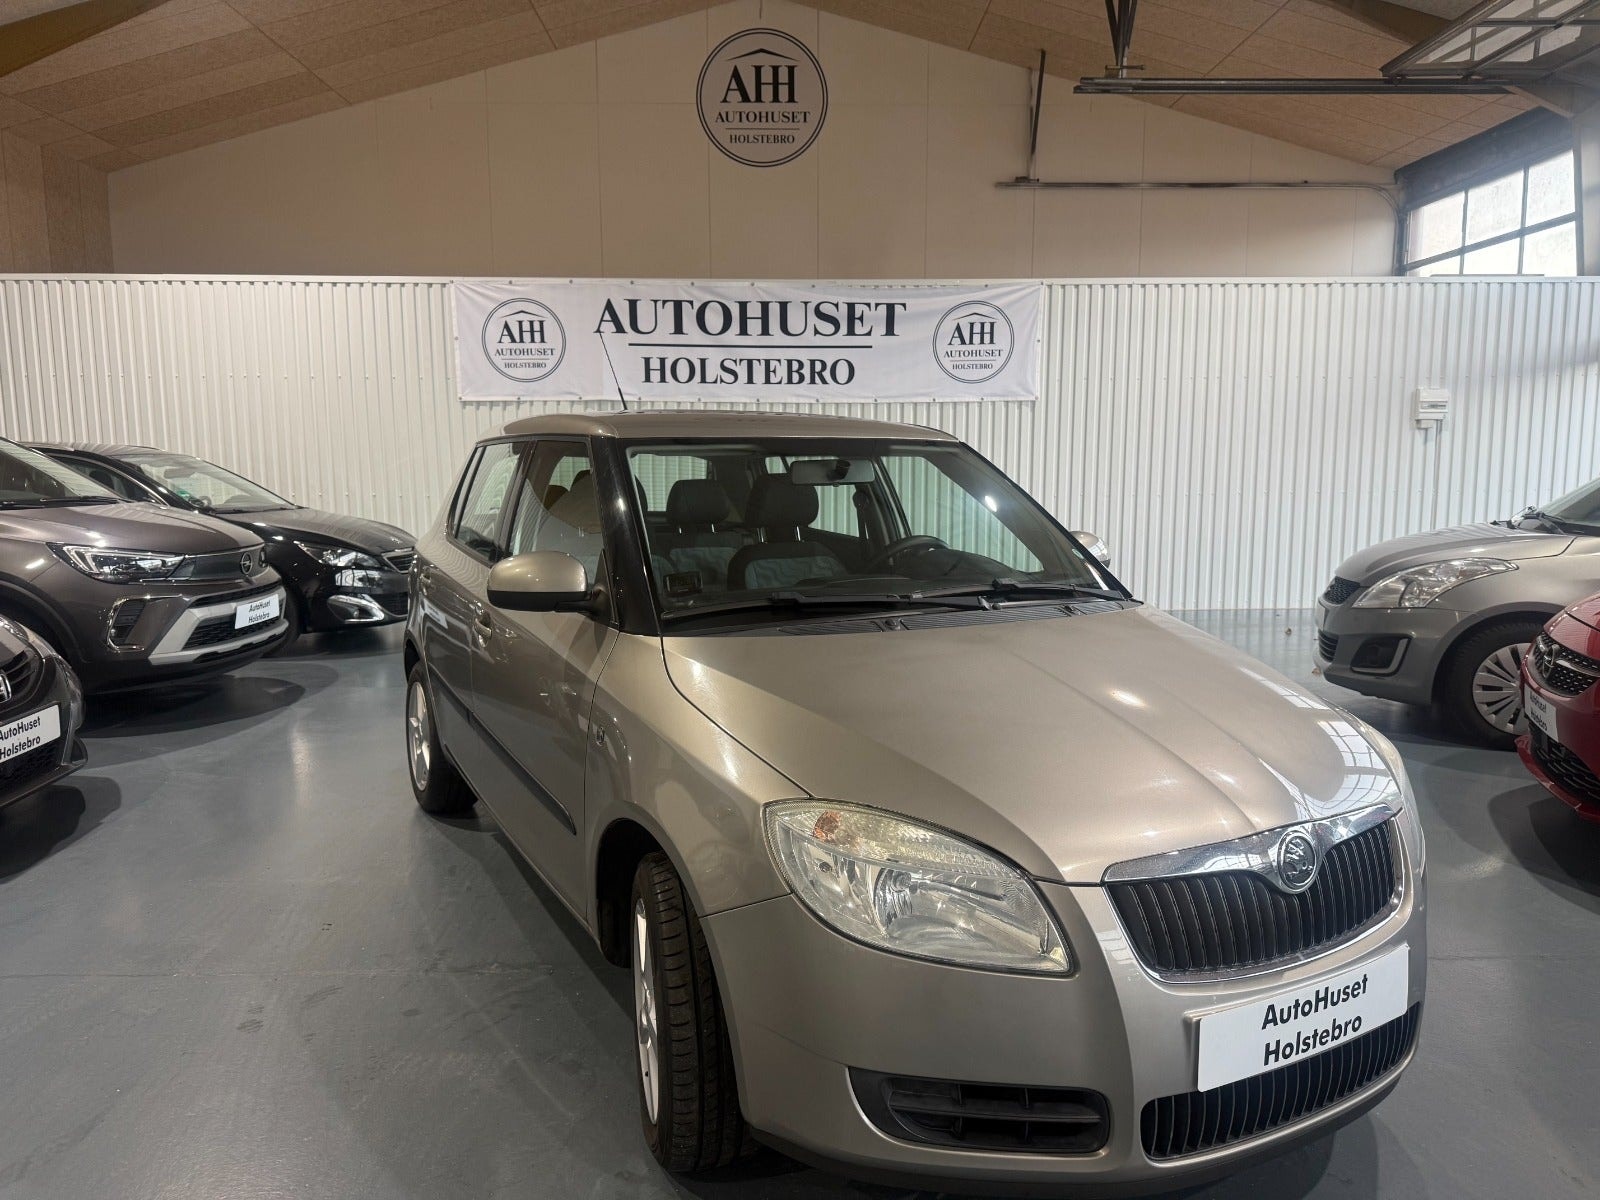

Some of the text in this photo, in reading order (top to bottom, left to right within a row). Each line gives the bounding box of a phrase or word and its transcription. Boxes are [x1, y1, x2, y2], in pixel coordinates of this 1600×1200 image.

[720, 64, 799, 104] AHH
[715, 110, 811, 124] AUTOHUSET
[729, 134, 796, 145] HOLSTEBRO
[594, 297, 906, 338] AUTOHUSET
[497, 319, 547, 344] AHH
[947, 321, 997, 346] AHH
[494, 347, 556, 357] AUTOHUSET
[943, 348, 1004, 359] AUTOHUSET
[504, 361, 547, 369] HOLSTEBRO
[641, 356, 856, 386] HOLSTEBRO
[1261, 973, 1368, 1030] AutoHuset
[1263, 1015, 1362, 1067] Holstebro
